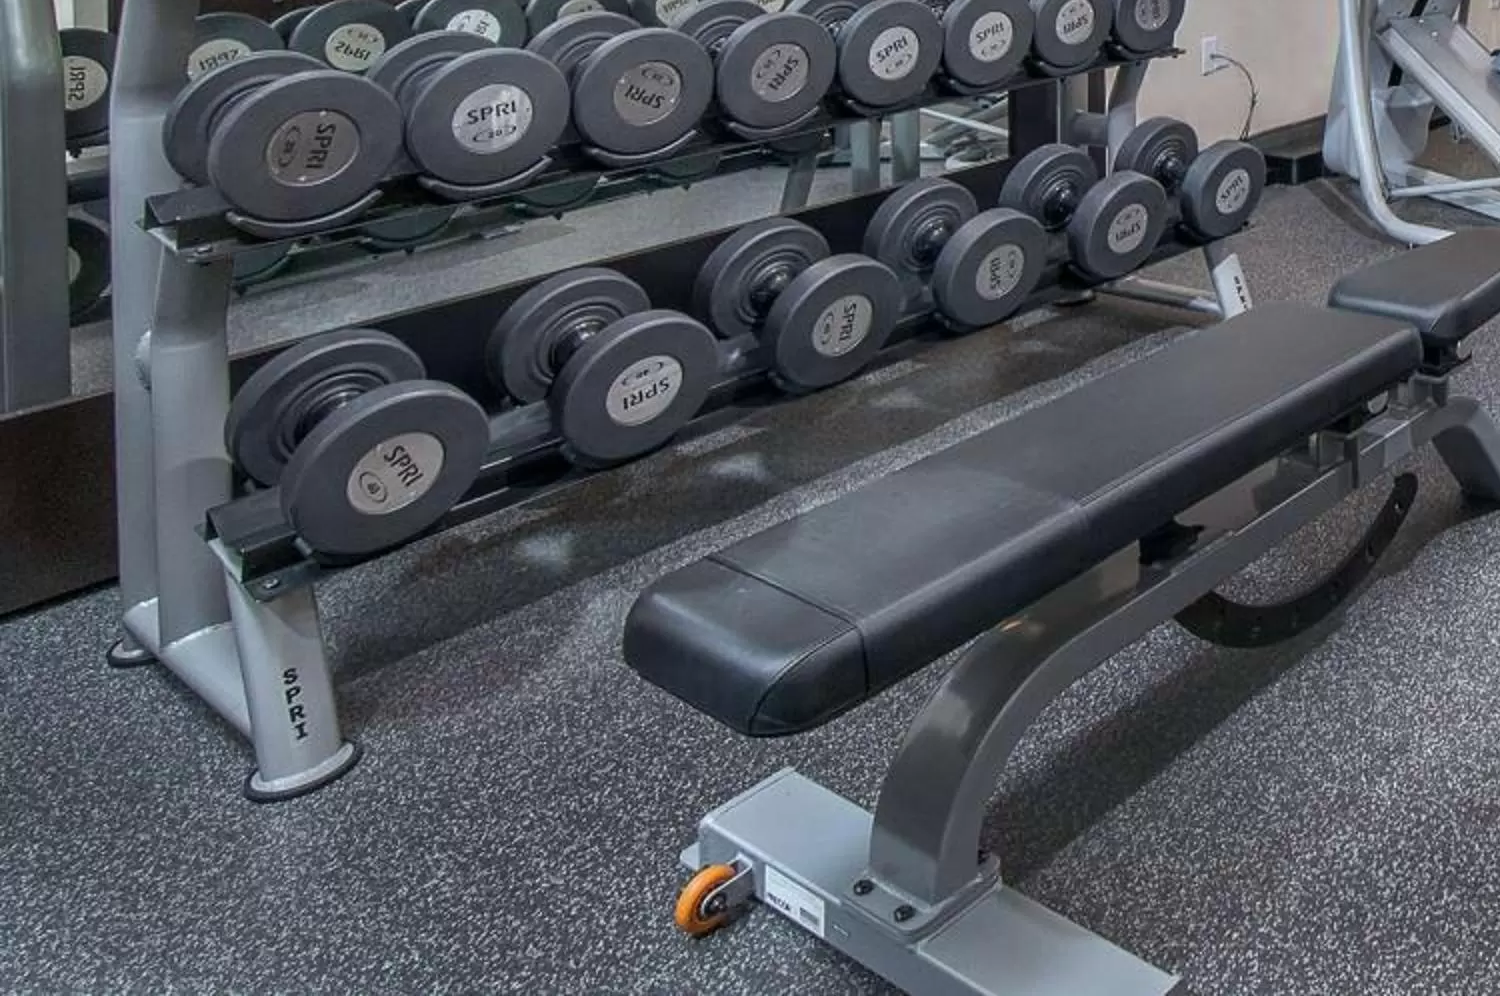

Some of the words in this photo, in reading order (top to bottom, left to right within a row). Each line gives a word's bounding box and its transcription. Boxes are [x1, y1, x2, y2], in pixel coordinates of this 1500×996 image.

[876, 35, 909, 63] SPRI
[976, 21, 1005, 45] SPRI
[768, 55, 799, 91] SPRI
[467, 100, 516, 125] SPRI
[624, 84, 666, 109] SPRI
[305, 123, 336, 170] SPRI
[839, 303, 857, 341] SPRI
[623, 377, 670, 410] SPRI
[384, 445, 424, 488] SPRI
[283, 667, 309, 741] SPRI
